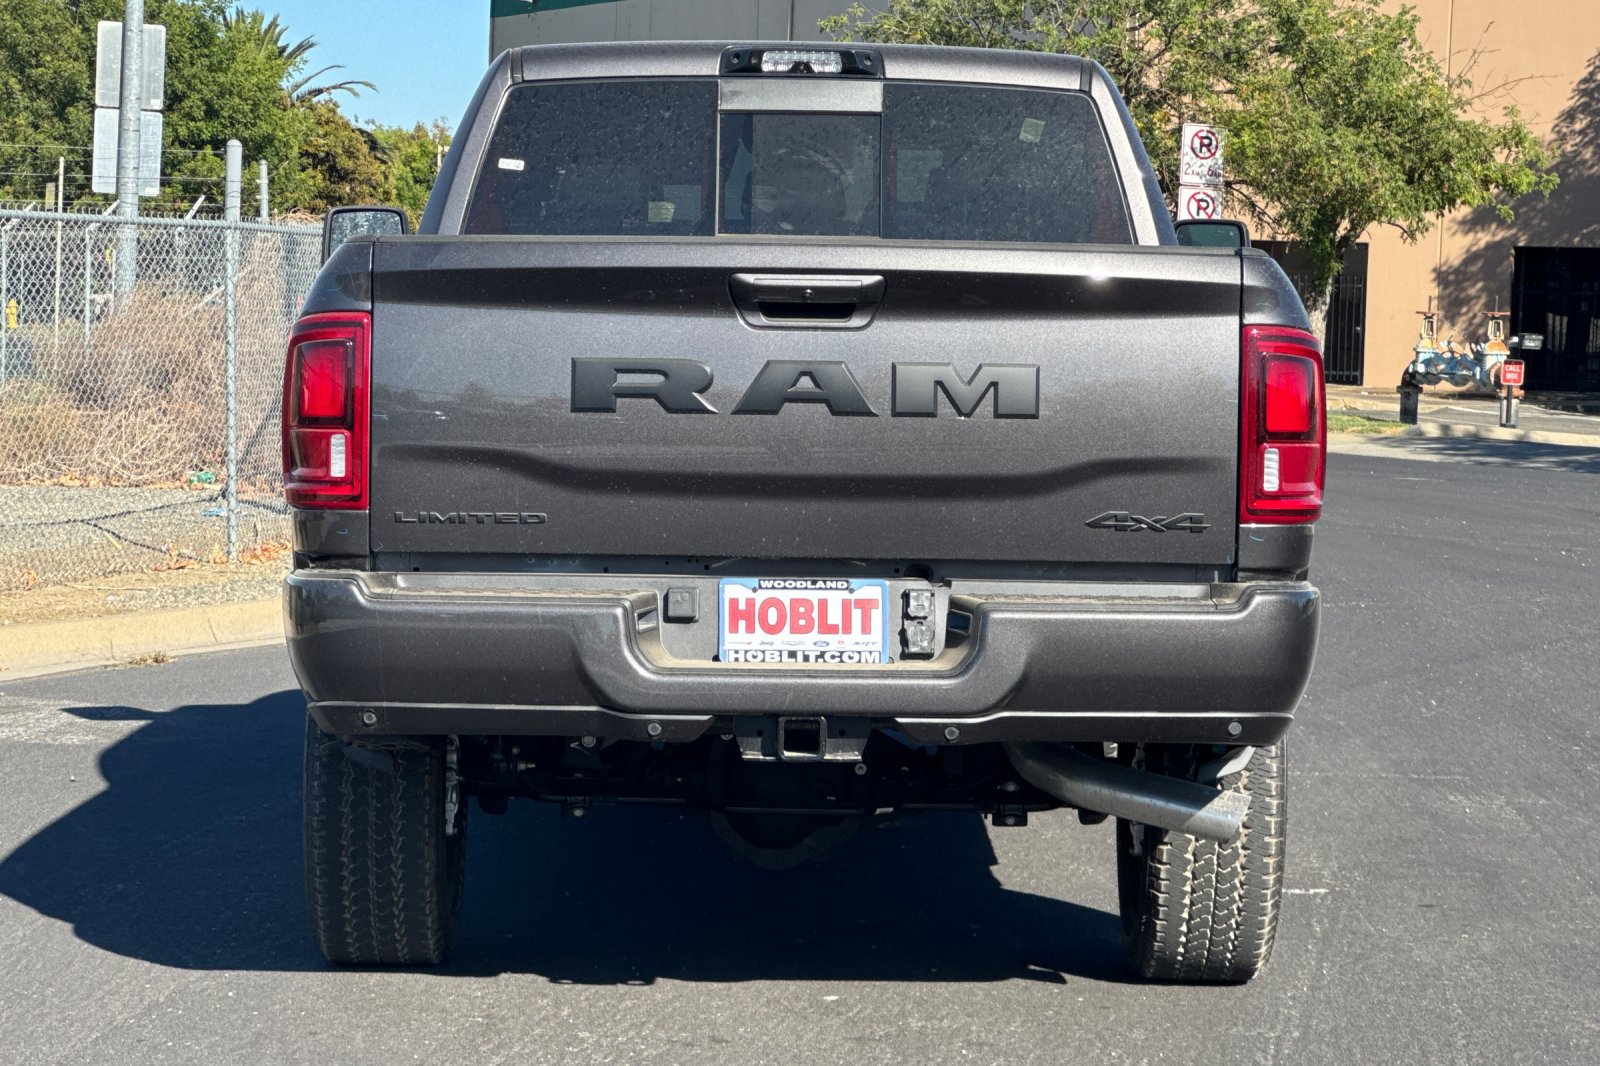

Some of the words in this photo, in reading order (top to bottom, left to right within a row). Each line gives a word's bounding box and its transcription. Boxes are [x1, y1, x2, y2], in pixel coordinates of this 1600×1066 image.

[570, 357, 1040, 419] RAM
[394, 511, 548, 524] LIMITED
[759, 580, 848, 589] WOODLAND
[728, 597, 879, 635] HOBLIT
[728, 650, 880, 663] HOBLIT.COM
